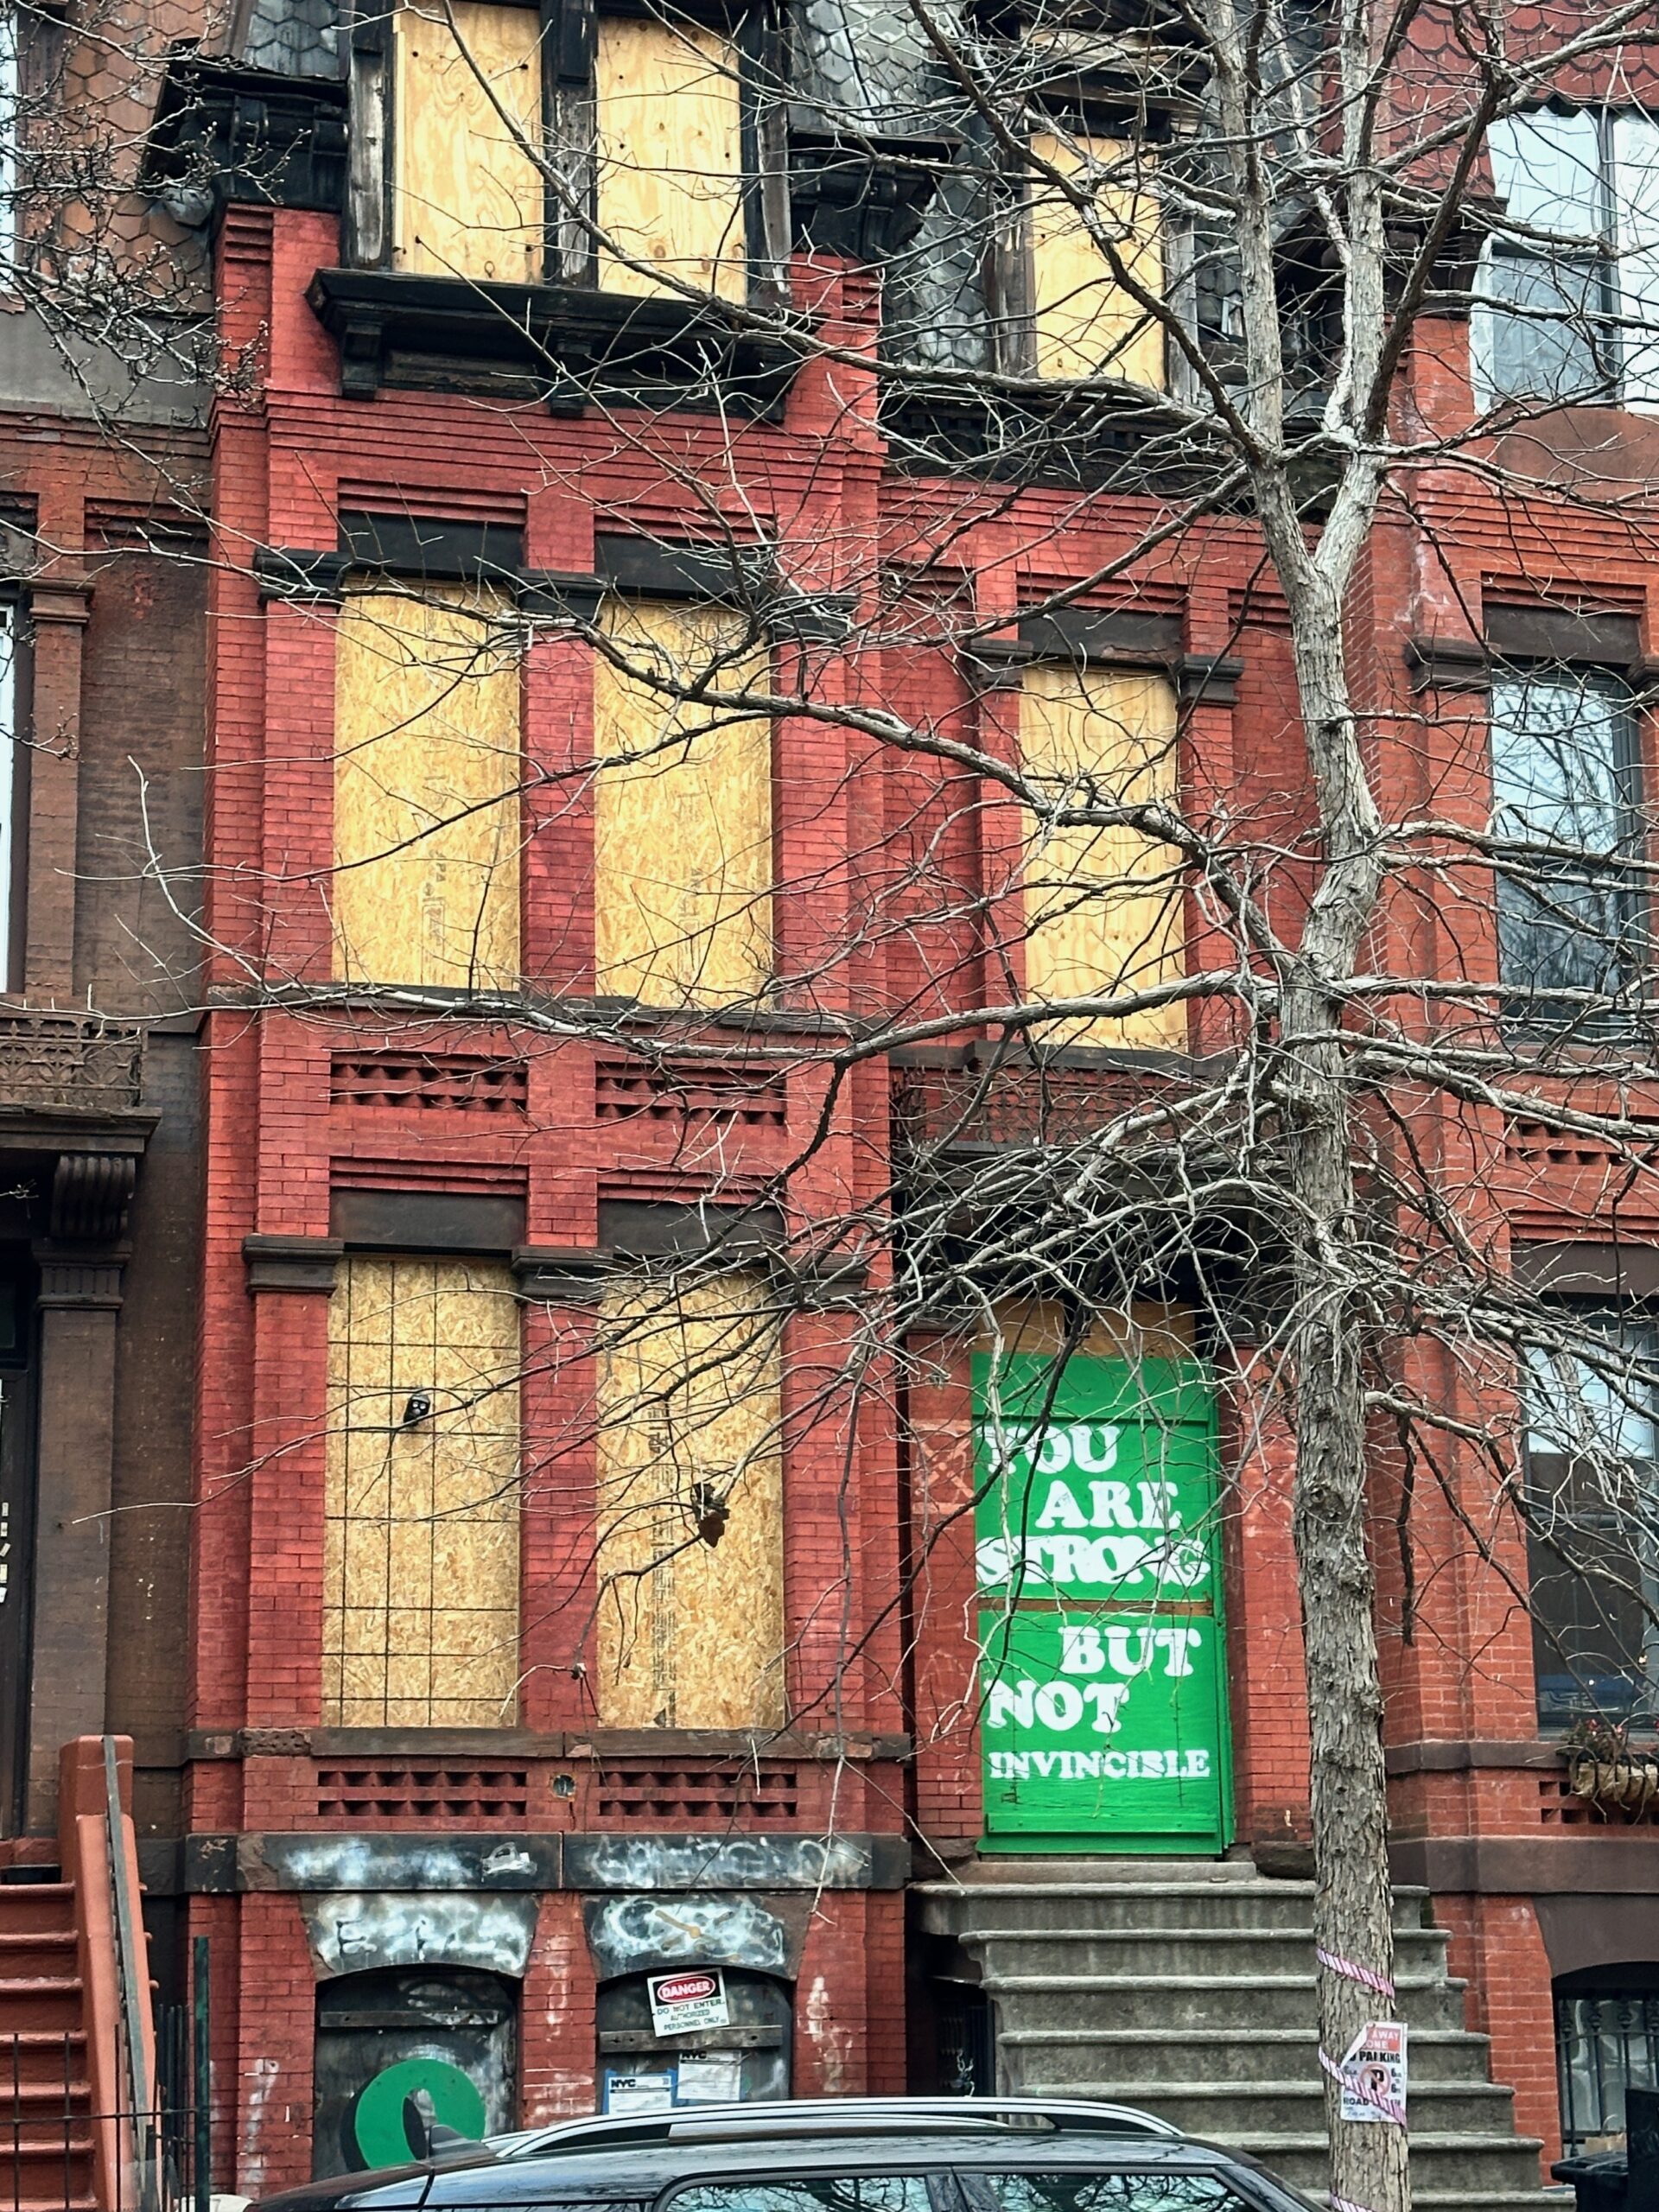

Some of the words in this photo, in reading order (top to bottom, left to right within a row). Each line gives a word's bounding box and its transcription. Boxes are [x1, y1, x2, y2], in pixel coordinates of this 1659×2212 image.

[976, 1425, 1121, 1474] YOU
[1036, 1480, 1182, 1529] ARE
[976, 1535, 1211, 1586] STRONG
[1059, 1625, 1202, 1676] BUT
[983, 1680, 1129, 1732] NOT
[988, 1750, 1211, 1780] INVINCIBLE
[662, 1981, 711, 1998] DANGER
[664, 2019, 701, 2031] PERSONNEL
[704, 2016, 720, 2024] ONLY
[671, 2009, 710, 2021] AUTHORIZED
[1372, 2029, 1400, 2040] AWAY
[1363, 2039, 1389, 2049] ONE
[682, 2050, 708, 2059] NYC
[611, 2078, 637, 2088] NYC
